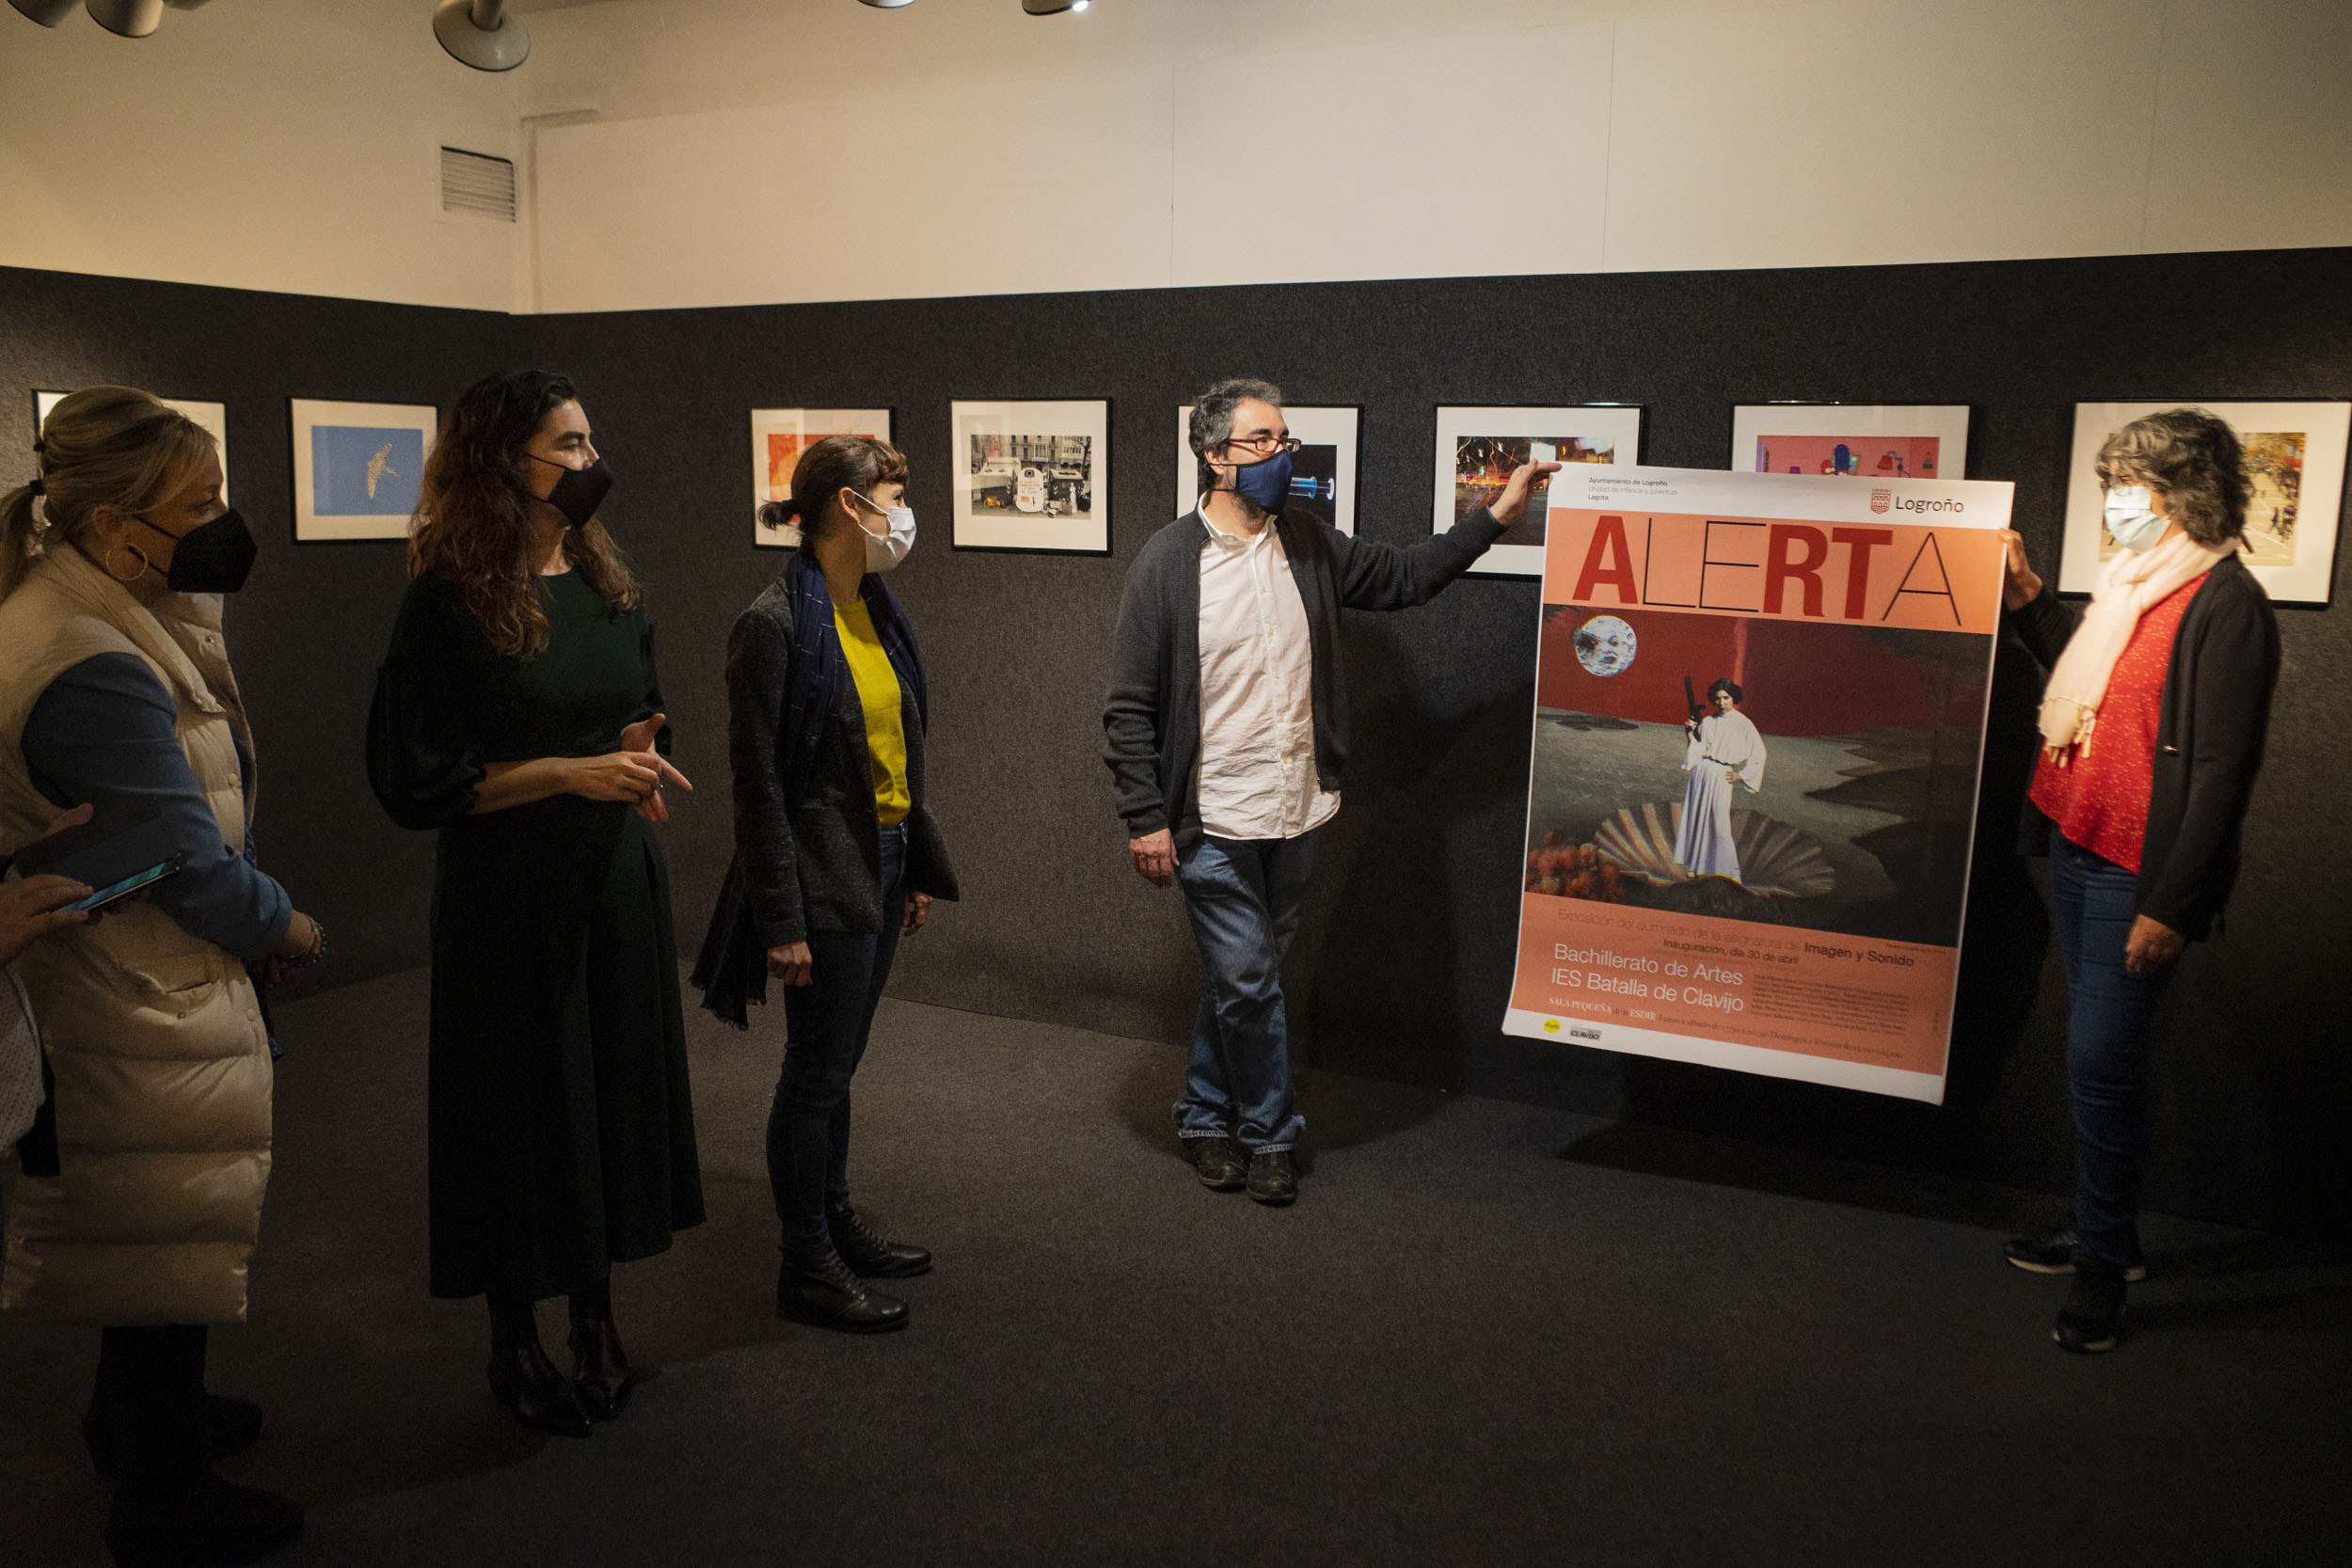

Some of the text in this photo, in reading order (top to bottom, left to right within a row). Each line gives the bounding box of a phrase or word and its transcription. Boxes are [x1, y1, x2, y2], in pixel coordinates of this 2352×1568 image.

[1589, 477, 1631, 485] Ayuntamiento
[1642, 479, 1668, 487] Logroño
[1588, 494, 1609, 502] Lagota
[1895, 495, 1964, 515] Logroño
[1572, 515, 1963, 626] ALERTA
[1555, 942, 1743, 986] Bachillerato de Artes
[1663, 939, 1727, 956] Inauguración,
[1747, 949, 1760, 959] 30
[1763, 953, 1776, 961] de
[1778, 955, 1799, 965] abril
[1804, 942, 1852, 959] Imagen
[1855, 950, 1864, 963] y
[1867, 950, 1915, 967] Sonido
[1551, 966, 1744, 1014] IES Batalla de Clavijo
